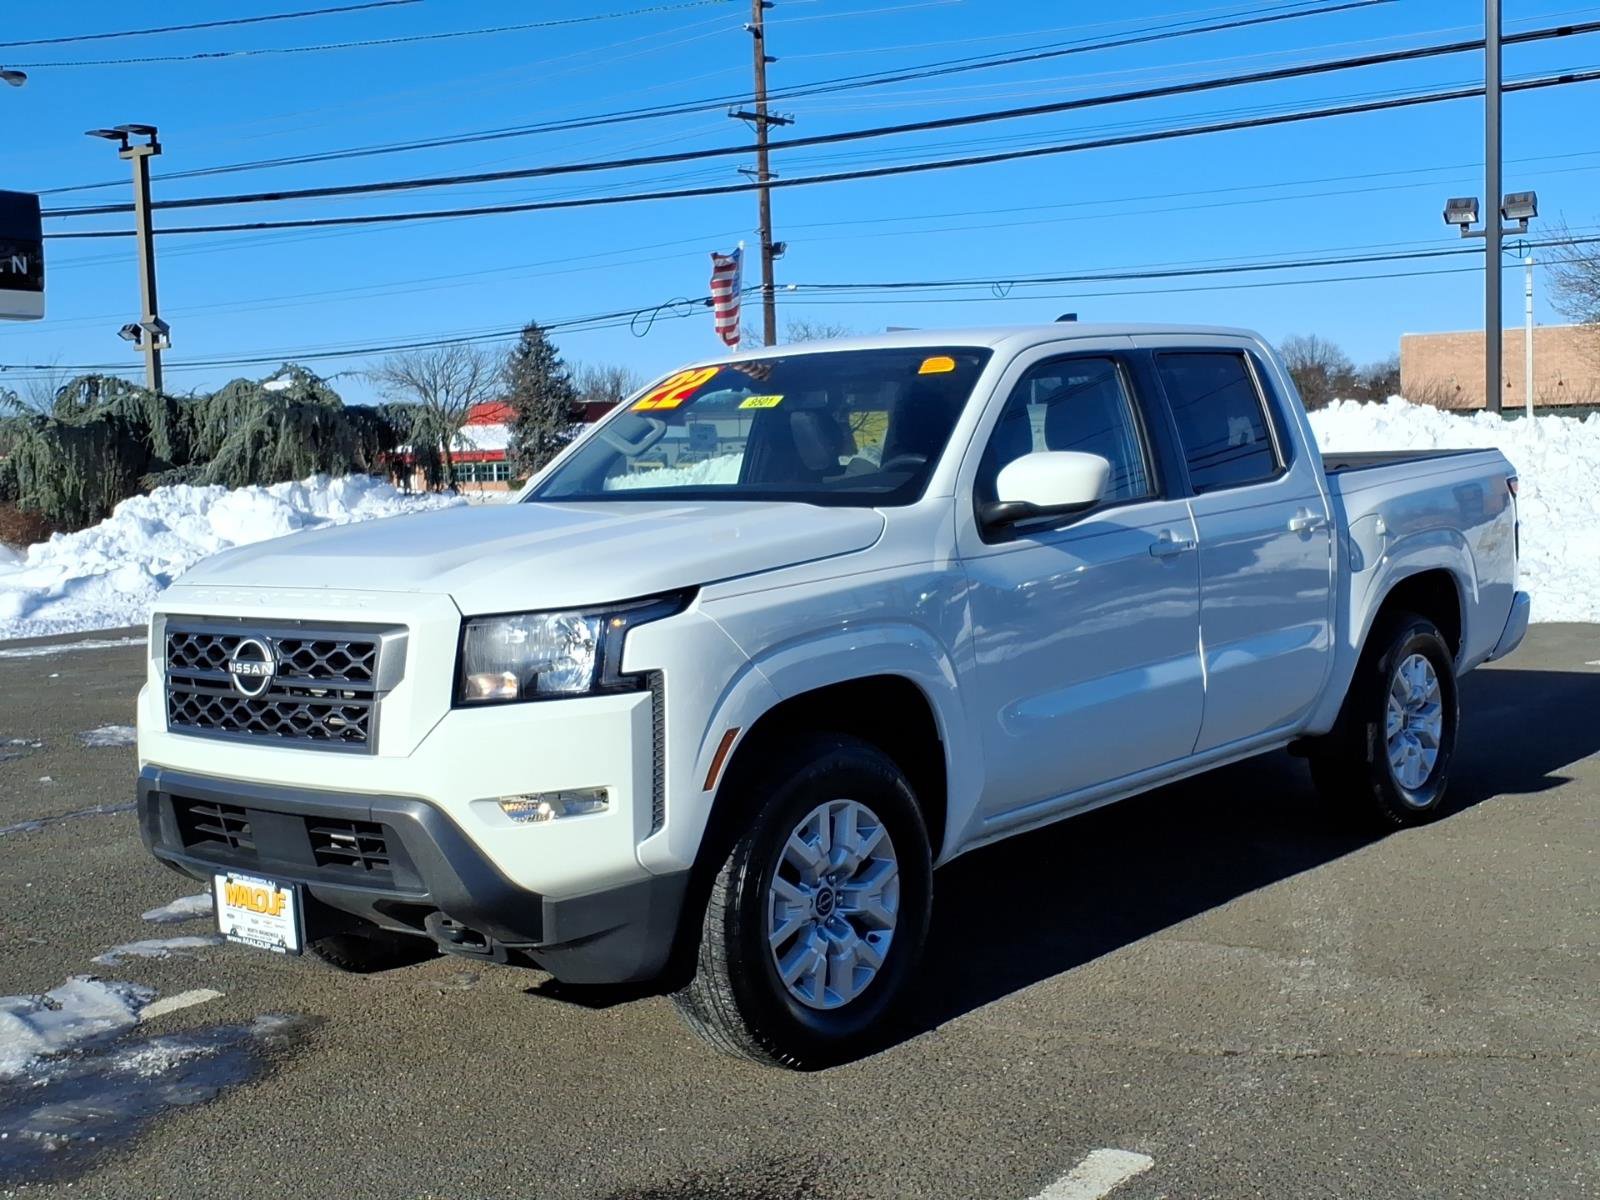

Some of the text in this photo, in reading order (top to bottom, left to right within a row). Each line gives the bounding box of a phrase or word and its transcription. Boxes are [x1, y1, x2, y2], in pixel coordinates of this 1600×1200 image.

[631, 366, 722, 411] 22
[228, 661, 274, 676] NISSAN
[225, 883, 286, 917] MALOUF
